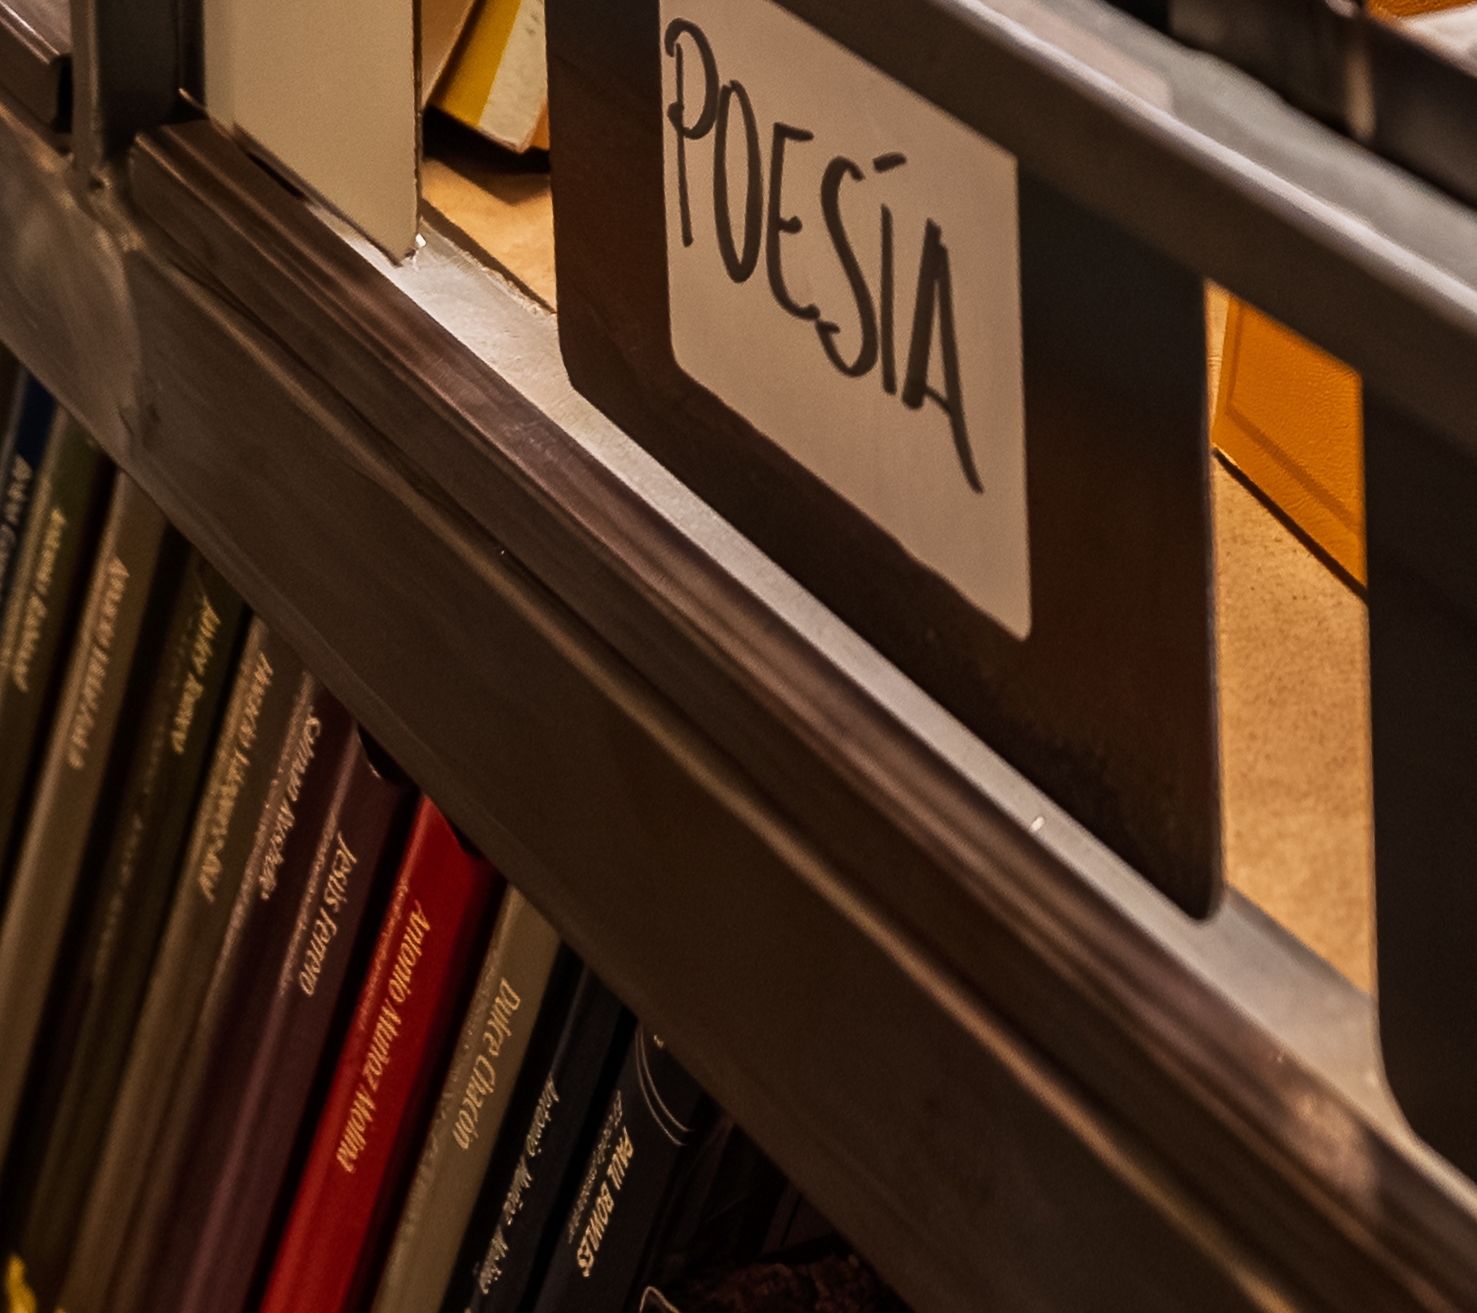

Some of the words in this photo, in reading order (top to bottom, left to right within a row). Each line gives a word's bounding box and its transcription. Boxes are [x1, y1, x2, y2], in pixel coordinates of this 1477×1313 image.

[664, 16, 985, 494] POESÍA
[325, 831, 357, 913] Jesús
[299, 907, 338, 997] Ferrero
[388, 898, 431, 1004] Antonio
[362, 997, 402, 1092] Muñoz
[482, 977, 522, 1057] Dulce
[336, 1083, 376, 1174] Molina
[452, 1054, 496, 1150] Chacón
[606, 1125, 634, 1190] PAUL
[576, 1180, 615, 1278] BOWLES
